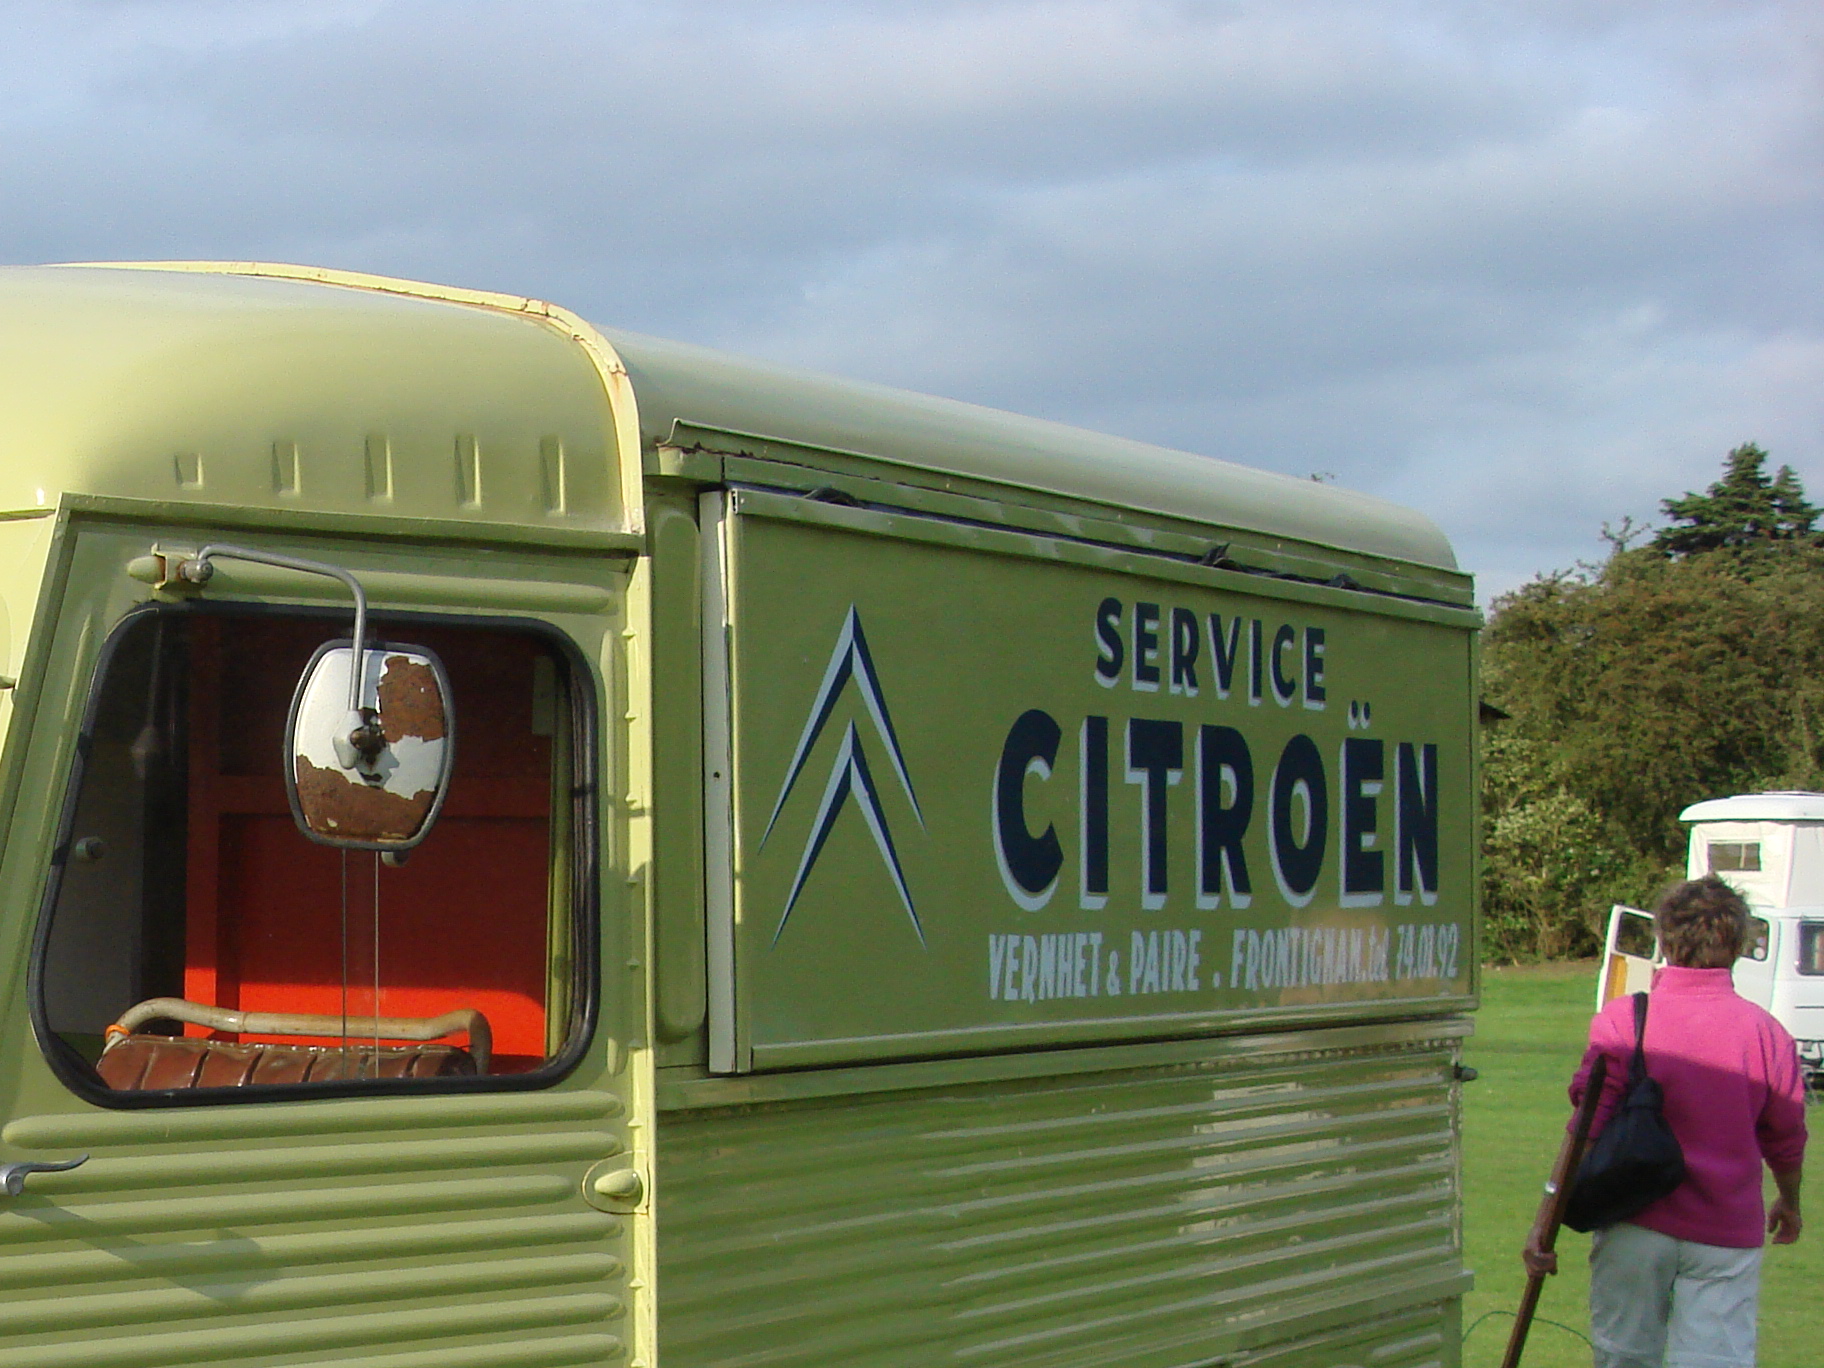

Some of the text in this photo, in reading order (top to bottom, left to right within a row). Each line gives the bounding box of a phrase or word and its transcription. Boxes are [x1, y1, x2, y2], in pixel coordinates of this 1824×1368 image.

[1094, 597, 1326, 710] SERVICE
[992, 700, 1439, 912] CITROËN
[988, 932, 1102, 1003] VERNHET
[1106, 950, 1121, 996] &
[1129, 929, 1201, 995] PAIRE
